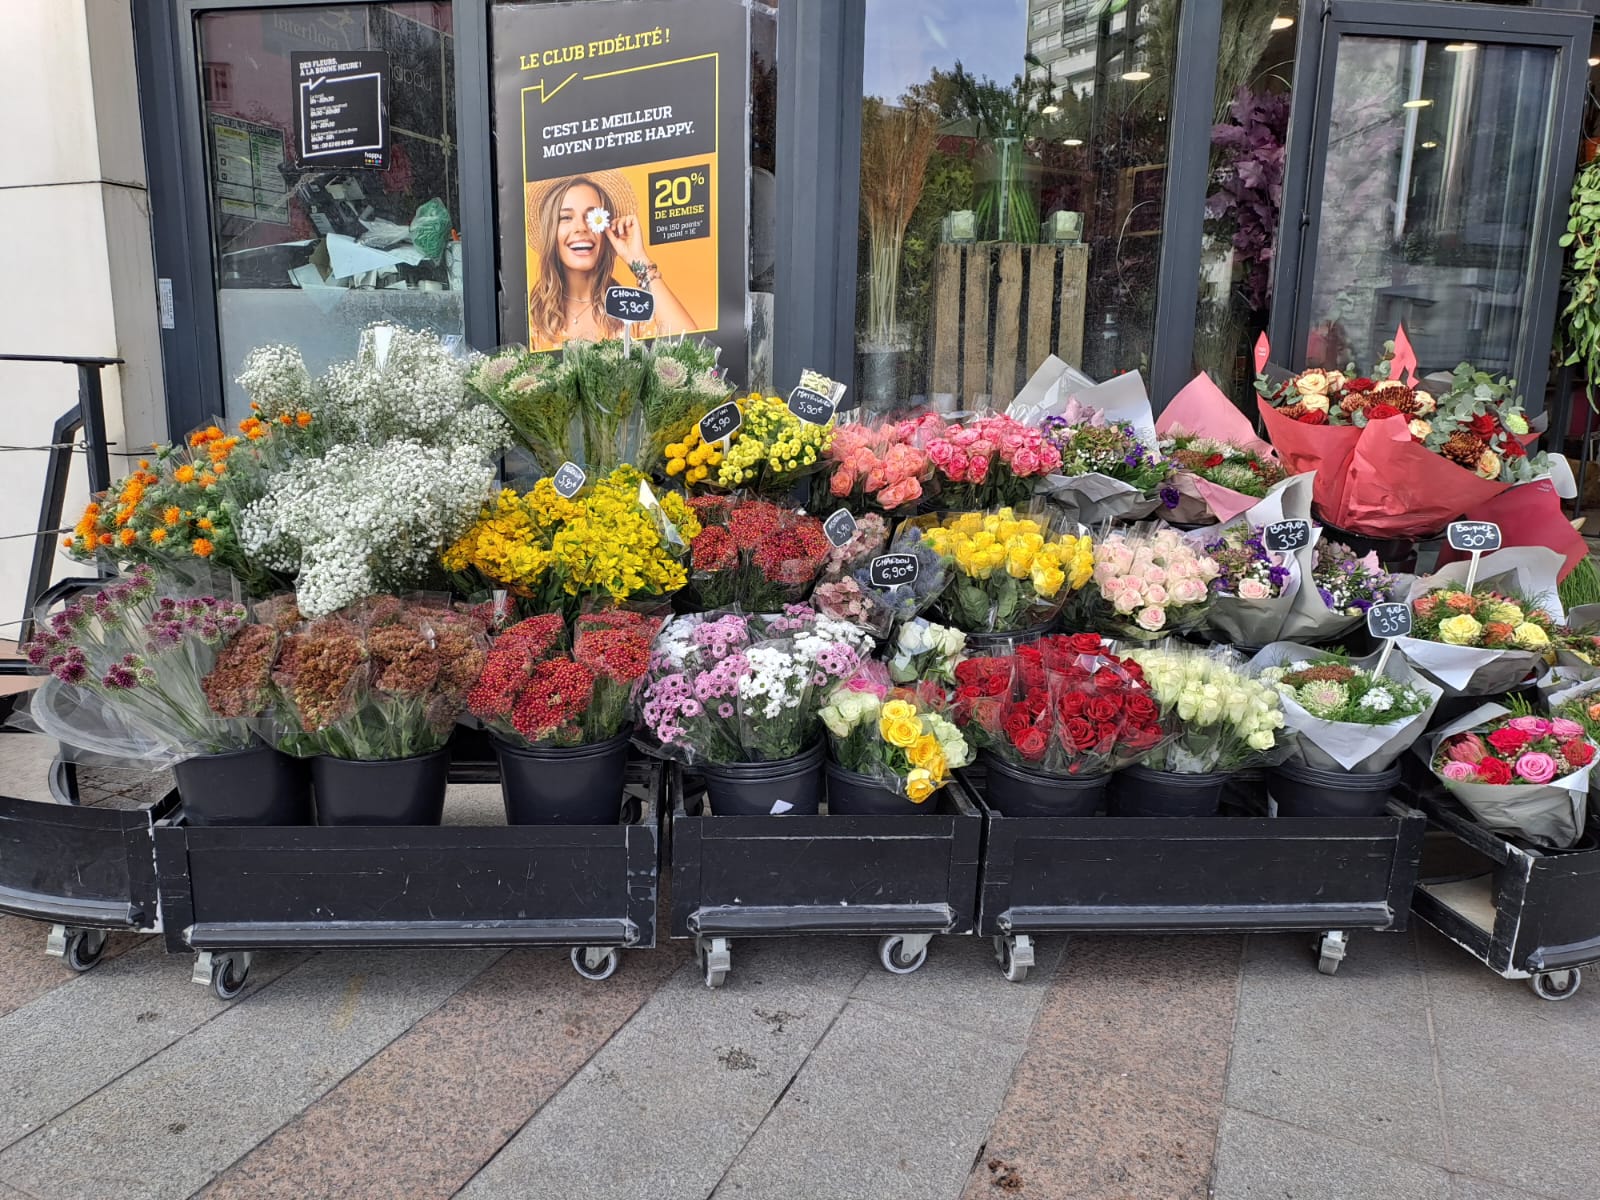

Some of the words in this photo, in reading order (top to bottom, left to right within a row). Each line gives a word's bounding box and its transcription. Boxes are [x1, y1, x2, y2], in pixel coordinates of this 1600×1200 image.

[520, 53, 540, 70] LE
[543, 44, 585, 66] CLUB
[588, 26, 663, 58] FIDÉLITÉ
[542, 121, 579, 139] C'EST
[582, 118, 599, 133] LE
[601, 105, 673, 129] MEILLEUR
[543, 138, 593, 158] MOYEN
[595, 129, 643, 150] D'ÊTRE
[645, 121, 695, 141] HAPPY.
[365, 151, 382, 160] happy
[655, 172, 705, 209] 20%
[655, 210, 668, 220] DE
[669, 204, 705, 218] REMISE
[667, 230, 683, 239] point
[669, 223, 680, 231] 150
[711, 416, 731, 432] 5,90
[1278, 529, 1305, 550] 35€
[875, 557, 910, 568] CHARDON
[882, 563, 914, 580] 6,90€
[1380, 613, 1407, 633] 35€
